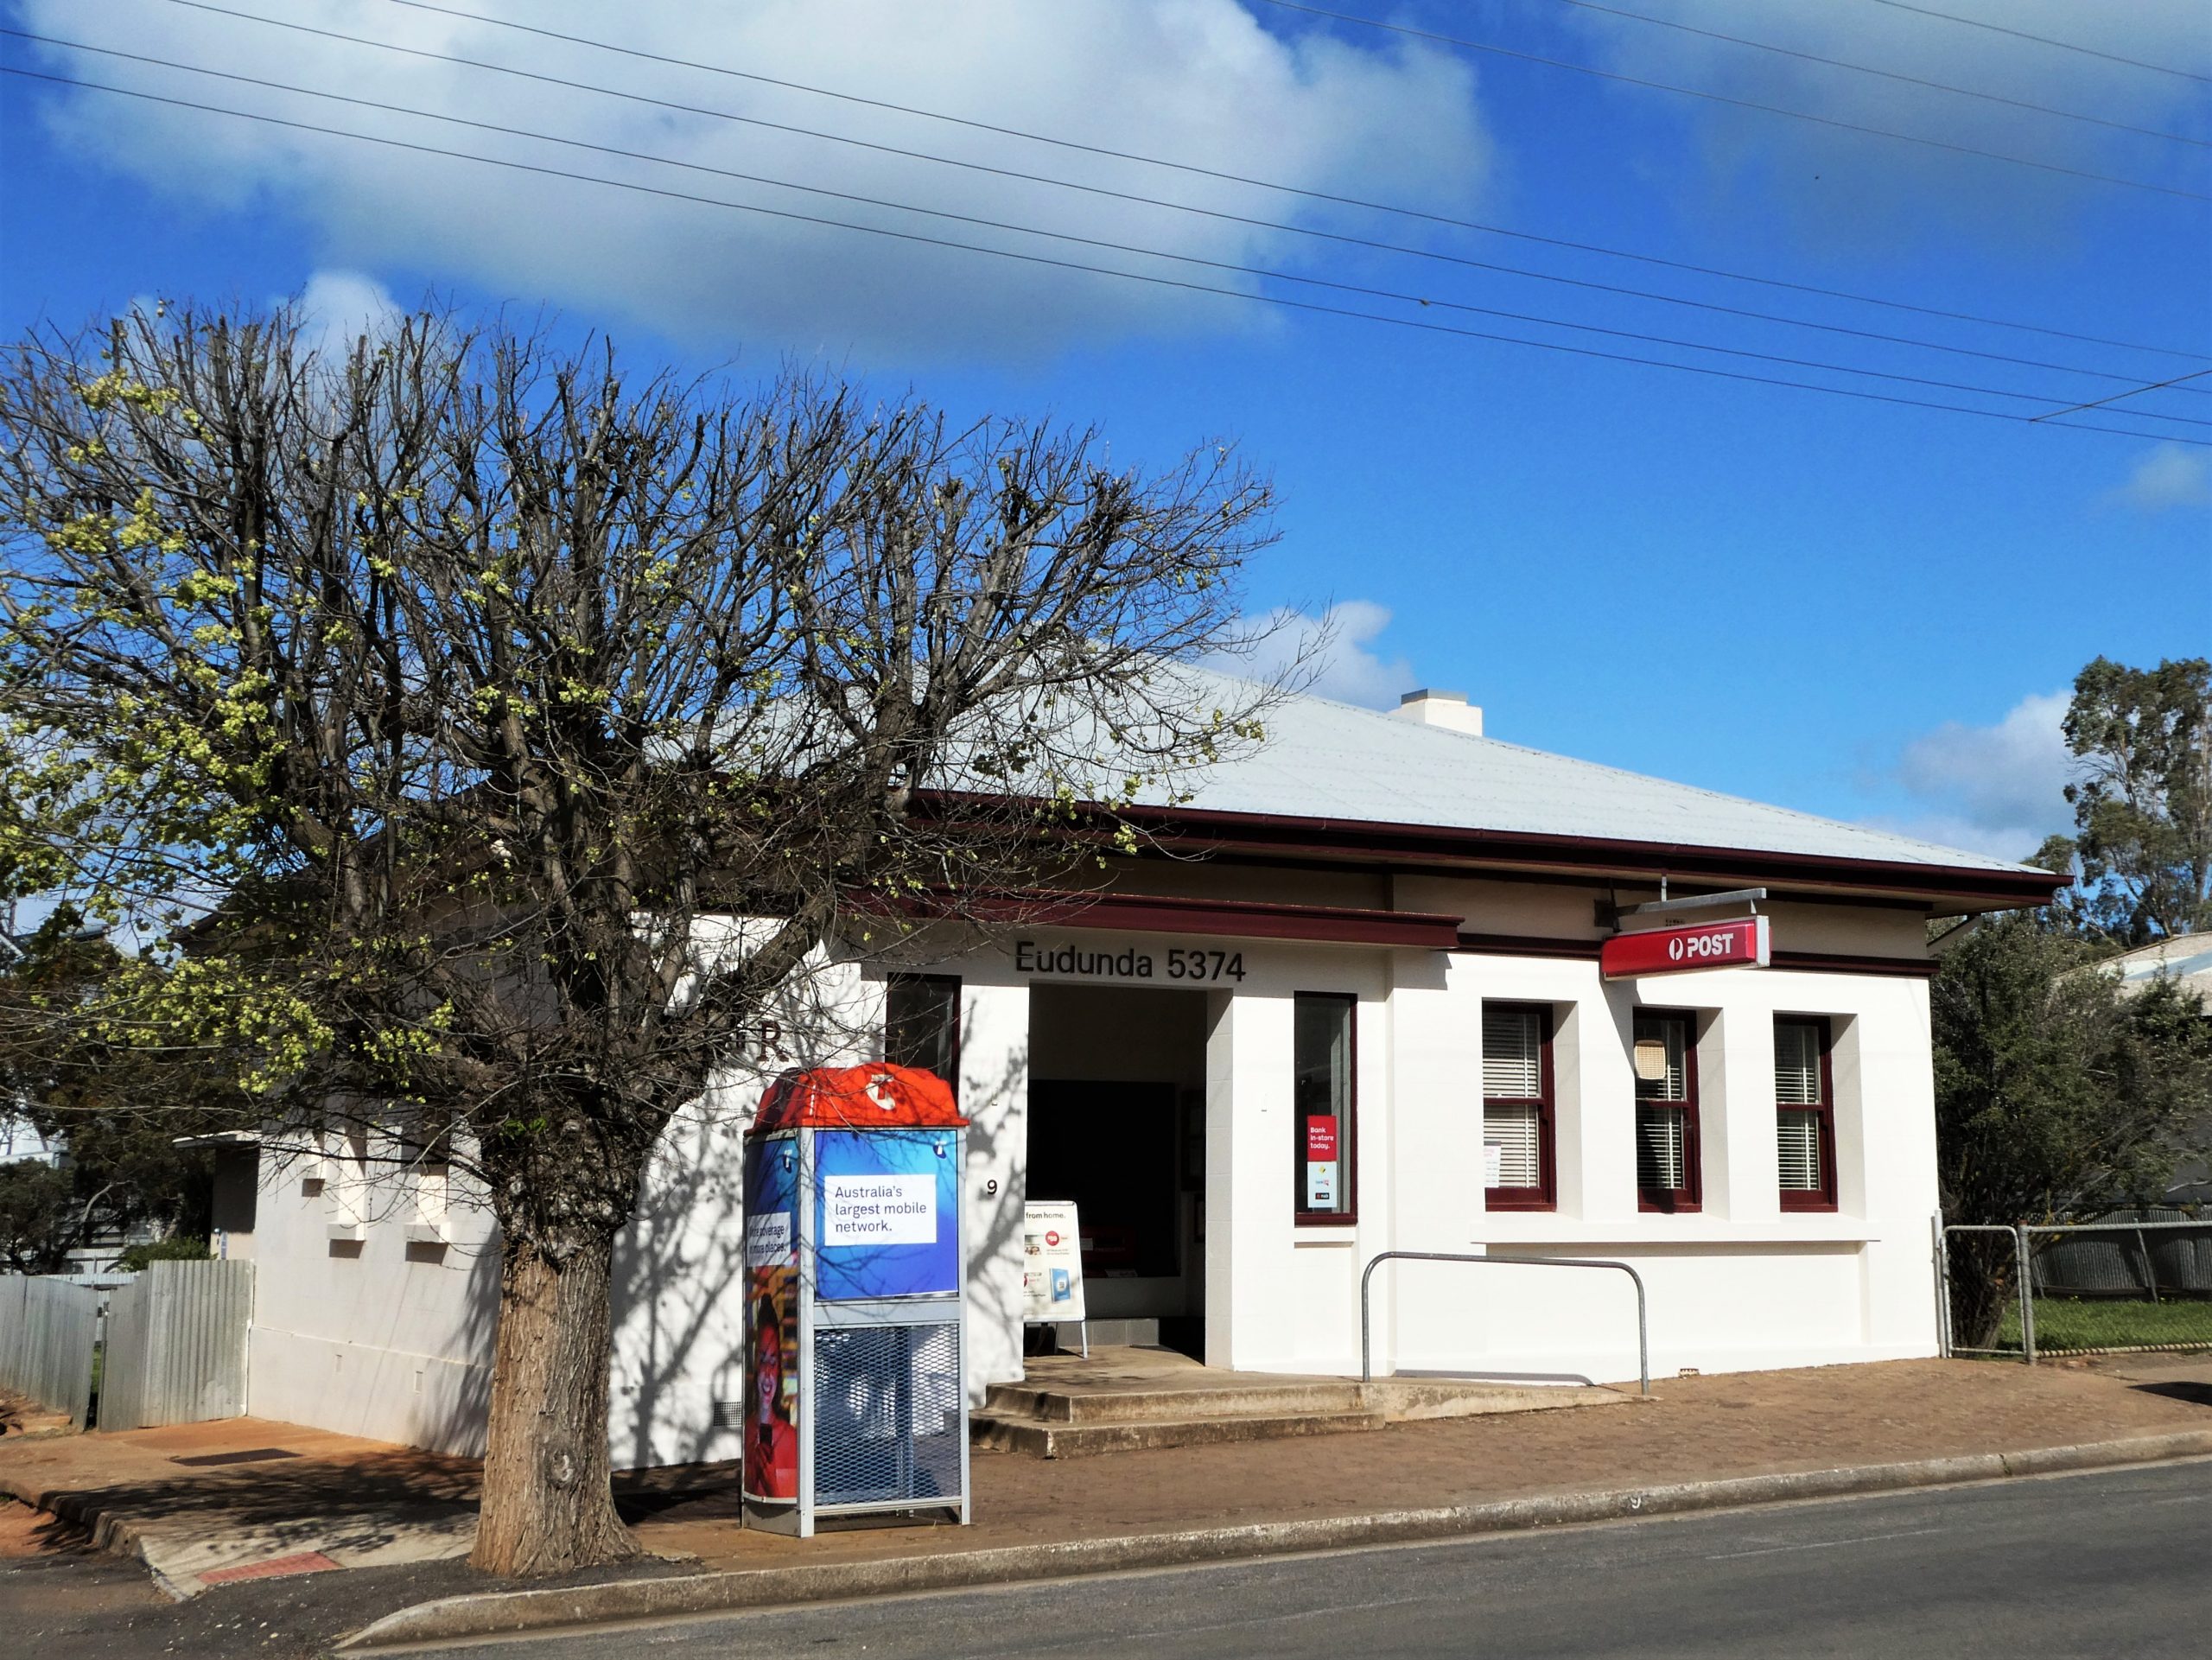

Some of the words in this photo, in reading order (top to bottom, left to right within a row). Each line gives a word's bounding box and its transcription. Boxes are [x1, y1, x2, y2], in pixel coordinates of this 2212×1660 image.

[1688, 933, 1733, 957] POST
[1016, 941, 1153, 978] Eudunda
[1168, 949, 1246, 982] 5374
[835, 1186, 903, 1198] Australia's
[987, 1179, 998, 1195] 9
[836, 1204, 880, 1218] largest
[884, 1202, 927, 1214] mobile
[836, 1219, 893, 1232] network.
